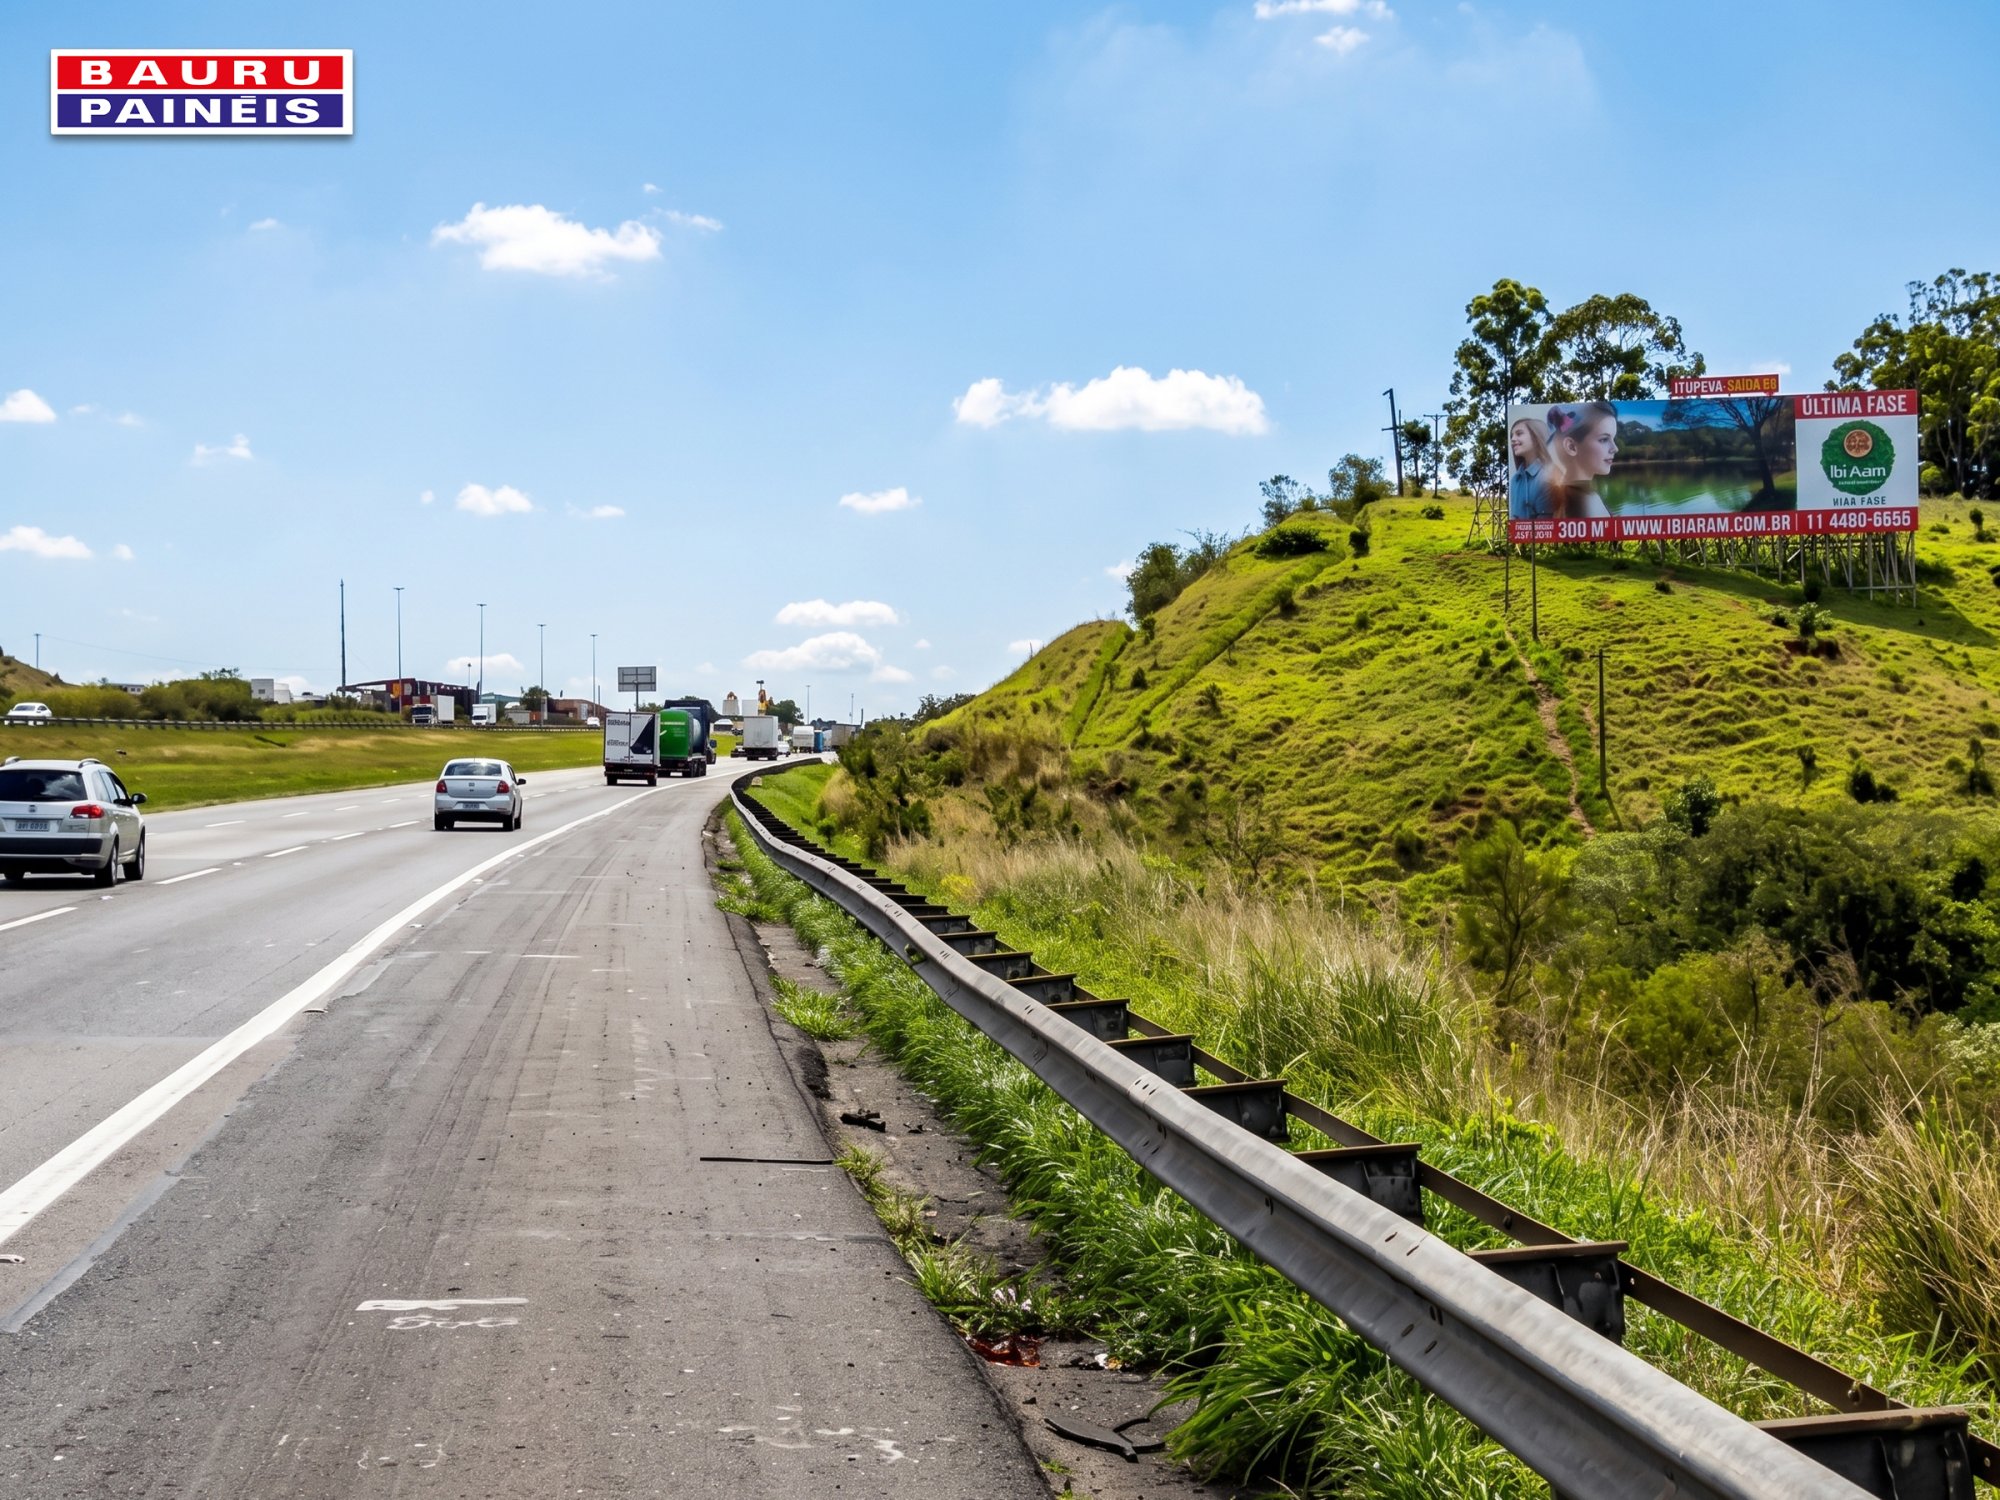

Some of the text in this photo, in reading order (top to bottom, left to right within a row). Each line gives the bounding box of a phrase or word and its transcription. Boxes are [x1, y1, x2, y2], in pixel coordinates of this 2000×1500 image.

[1727, 378, 1761, 391] SAÍDA
[1802, 394, 1907, 416] ÚLTIMA FASE
[1849, 465, 1887, 478] Aam
[1861, 496, 1887, 506] FASE
[1558, 521, 1587, 538] 300
[1622, 514, 1791, 536] WWW.IBIARAM.COM.BR
[1807, 513, 1823, 530] 11
